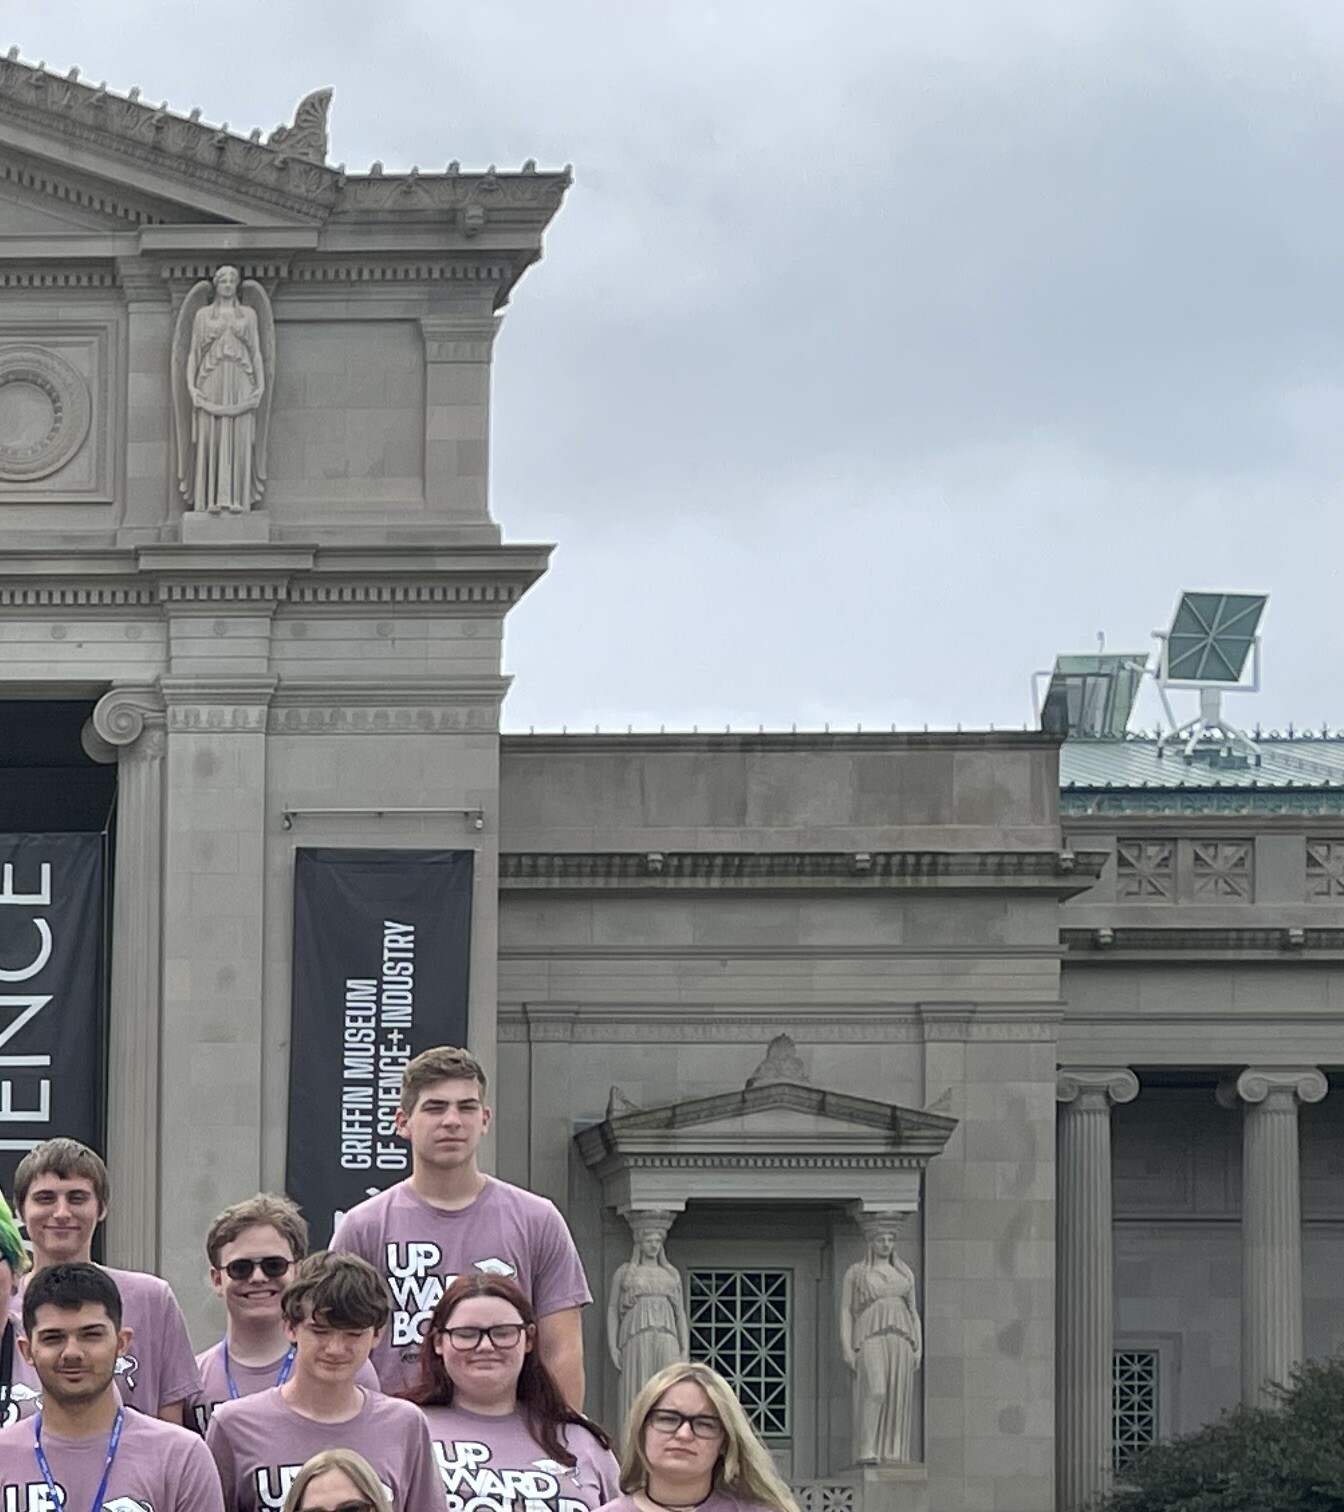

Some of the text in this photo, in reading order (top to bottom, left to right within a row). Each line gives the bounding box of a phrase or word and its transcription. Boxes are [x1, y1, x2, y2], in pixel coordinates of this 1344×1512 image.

[341, 978, 378, 1170] GRIFFIN MUSEUM
[376, 1142, 408, 1170] OF
[386, 1241, 442, 1278] UP
